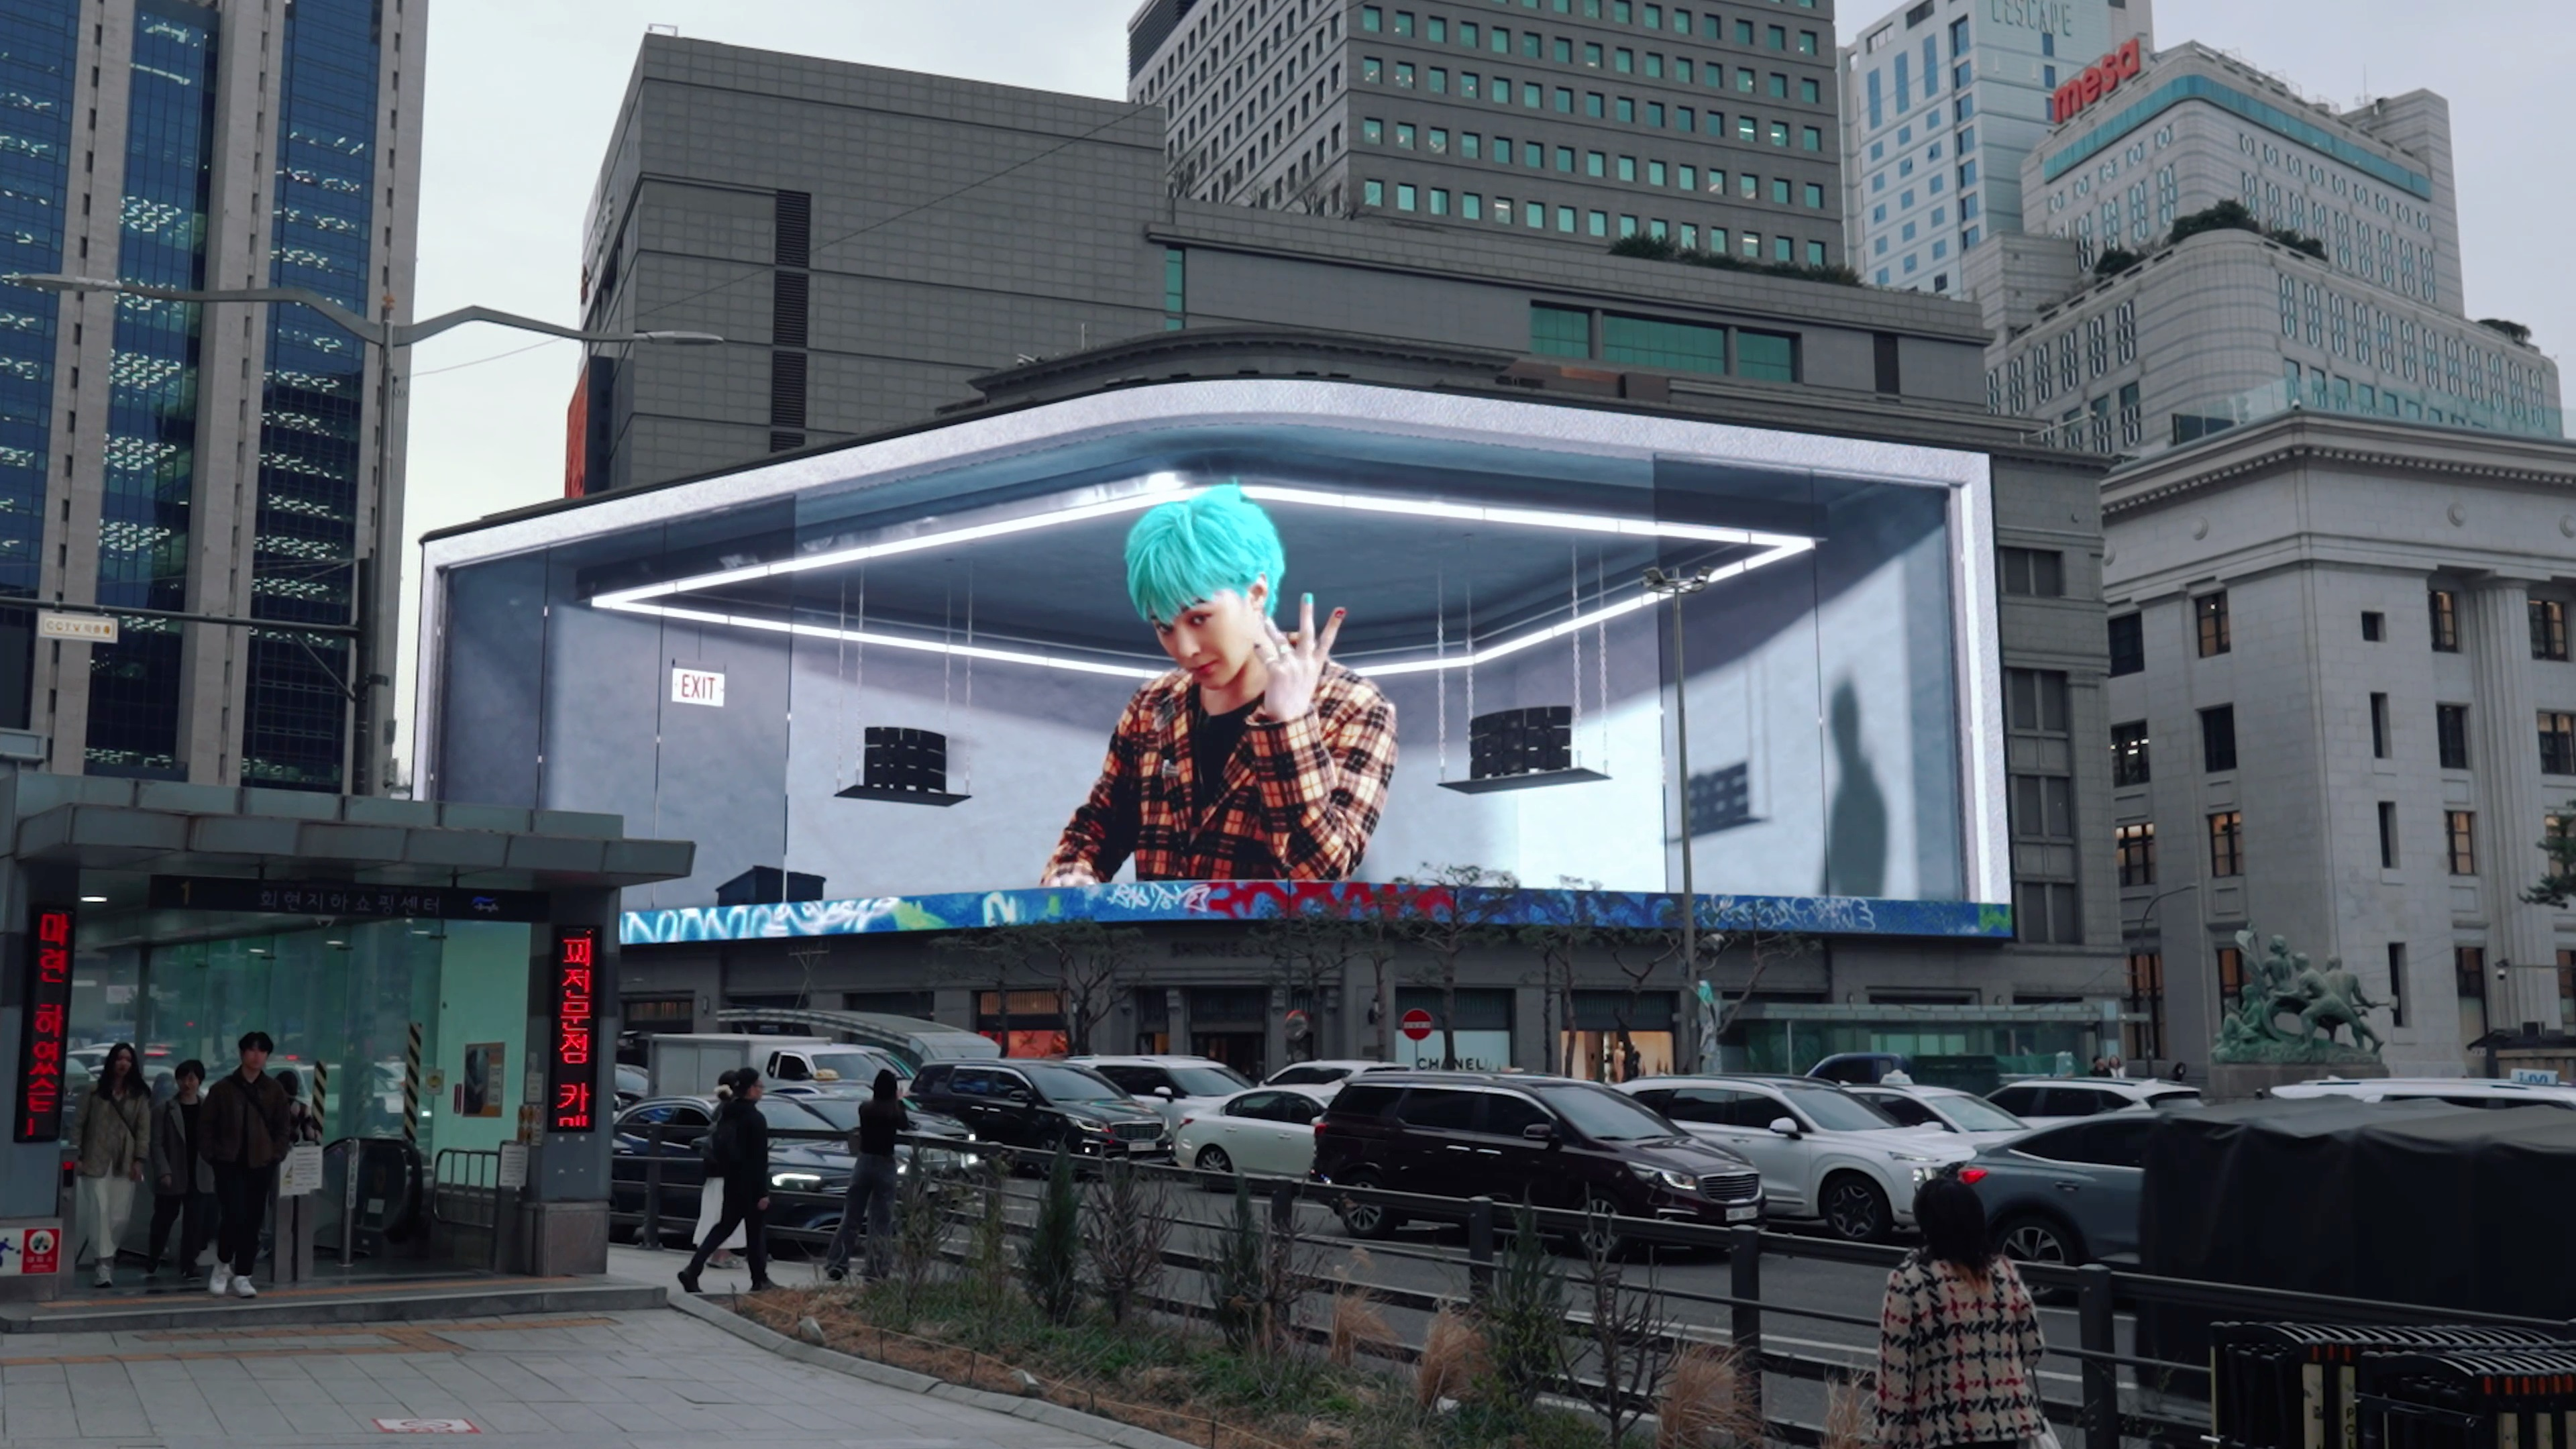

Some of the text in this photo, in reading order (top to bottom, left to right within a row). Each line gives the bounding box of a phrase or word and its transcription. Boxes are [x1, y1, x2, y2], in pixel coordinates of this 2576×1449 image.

[2053, 38, 2141, 123] mesa
[46, 621, 80, 631] CCTV
[681, 674, 716, 700] EXIT
[181, 881, 440, 915] 1 회현지하쇼핑센터
[1416, 1057, 1485, 1071] CHNEL
